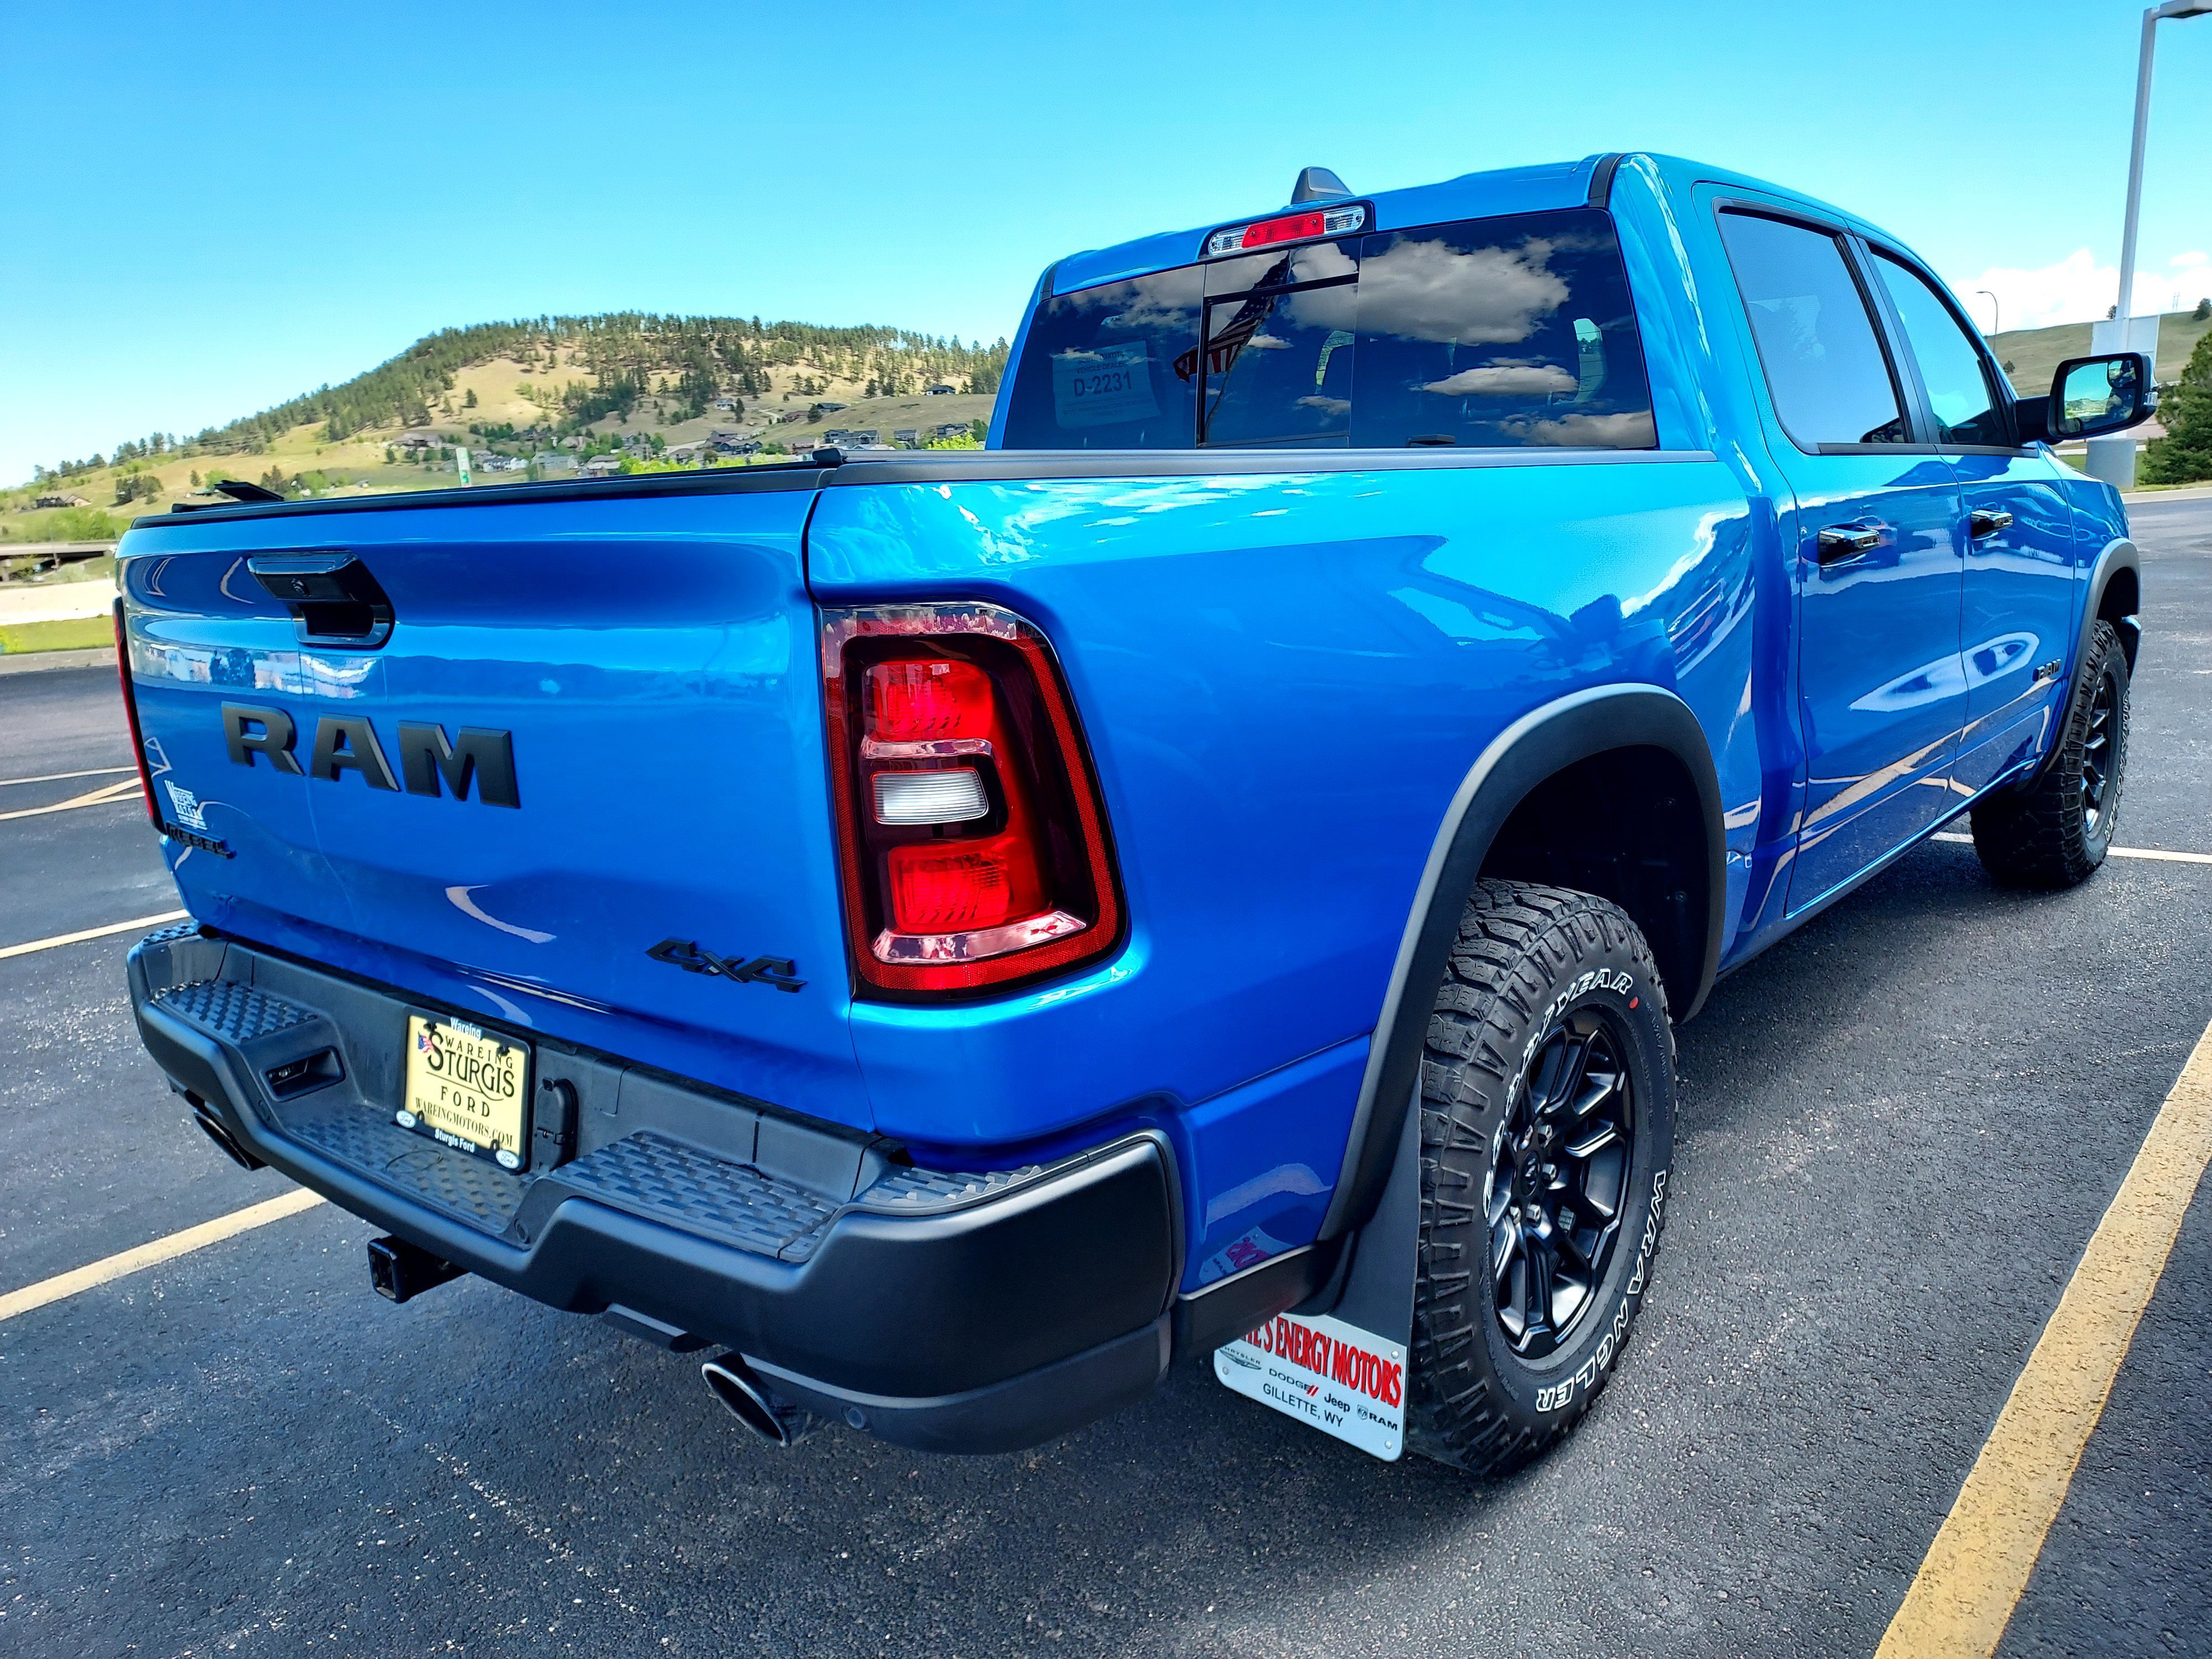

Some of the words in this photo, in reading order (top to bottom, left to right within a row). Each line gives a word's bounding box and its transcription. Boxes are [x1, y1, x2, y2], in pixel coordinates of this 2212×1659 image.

[1074, 371, 1132, 398] D-2231
[2033, 659, 2062, 681] RAM
[221, 701, 520, 808] RAM
[451, 1016, 482, 1041] Wareing
[427, 1031, 515, 1101] STURGIS
[445, 1035, 513, 1069] WAREING
[441, 1086, 490, 1117] FORD
[415, 1097, 513, 1147] WAREINGMOTORS.COM
[435, 1128, 459, 1147] Sturgis
[459, 1136, 476, 1153] Ford
[1536, 1169, 1667, 1412] WRANGLER
[1275, 1316, 1331, 1377] ENERGY
[1332, 1339, 1401, 1408] MOTORS
[1269, 1368, 1311, 1391] DODGE
[1263, 1383, 1321, 1420] GILLETTE,
[1324, 1410, 1343, 1428] WY
[1324, 1393, 1350, 1412] Jeep
[1369, 1412, 1397, 1431] RAM
